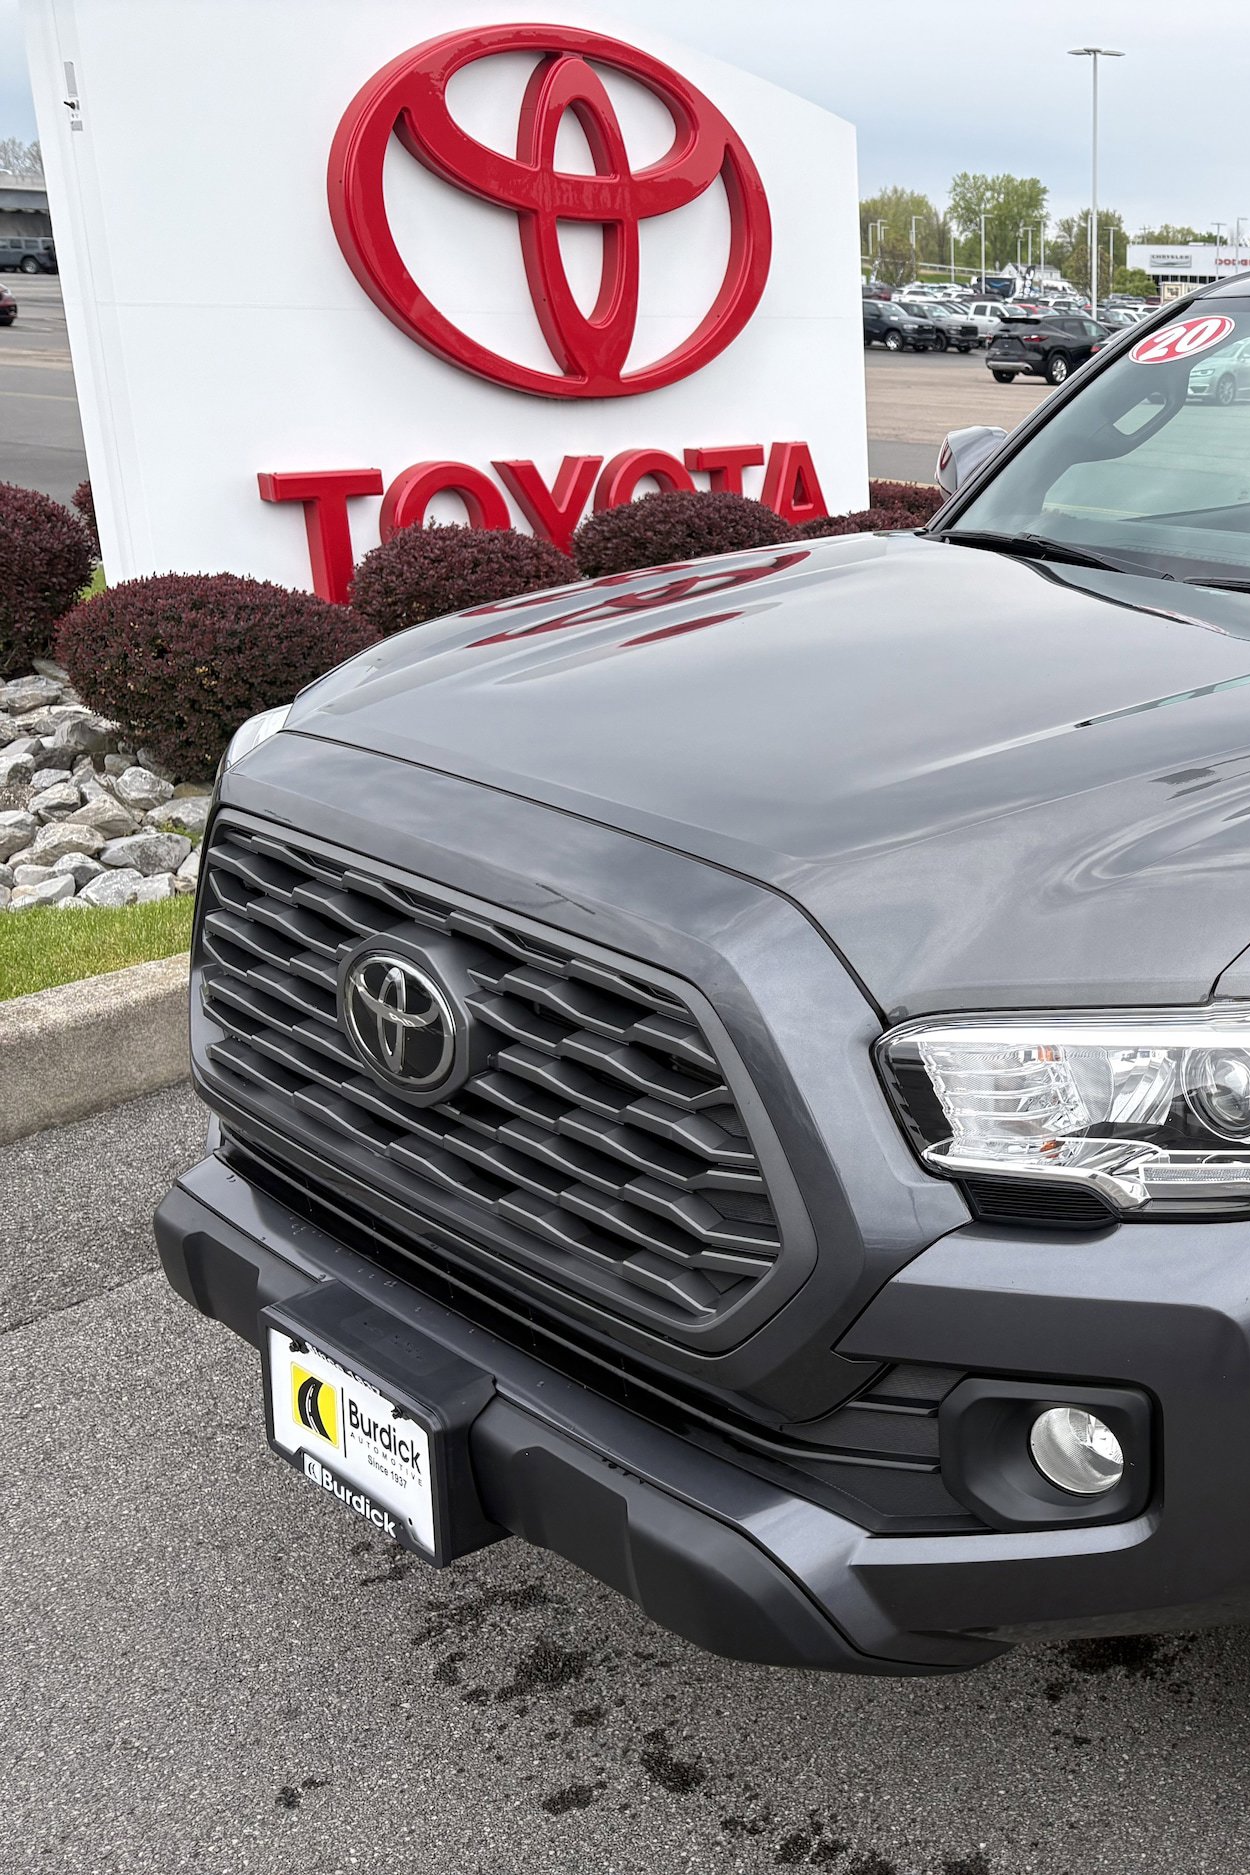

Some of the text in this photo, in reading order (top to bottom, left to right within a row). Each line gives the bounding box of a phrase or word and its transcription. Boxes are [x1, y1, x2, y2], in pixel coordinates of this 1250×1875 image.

[1138, 318, 1222, 362] 20
[258, 441, 829, 604] TOYOTA
[348, 1398, 421, 1475] Burdick
[350, 1431, 423, 1487] AUTOMOTIVE
[367, 1454, 408, 1489] Since 1937
[321, 1468, 397, 1539] Burdick
